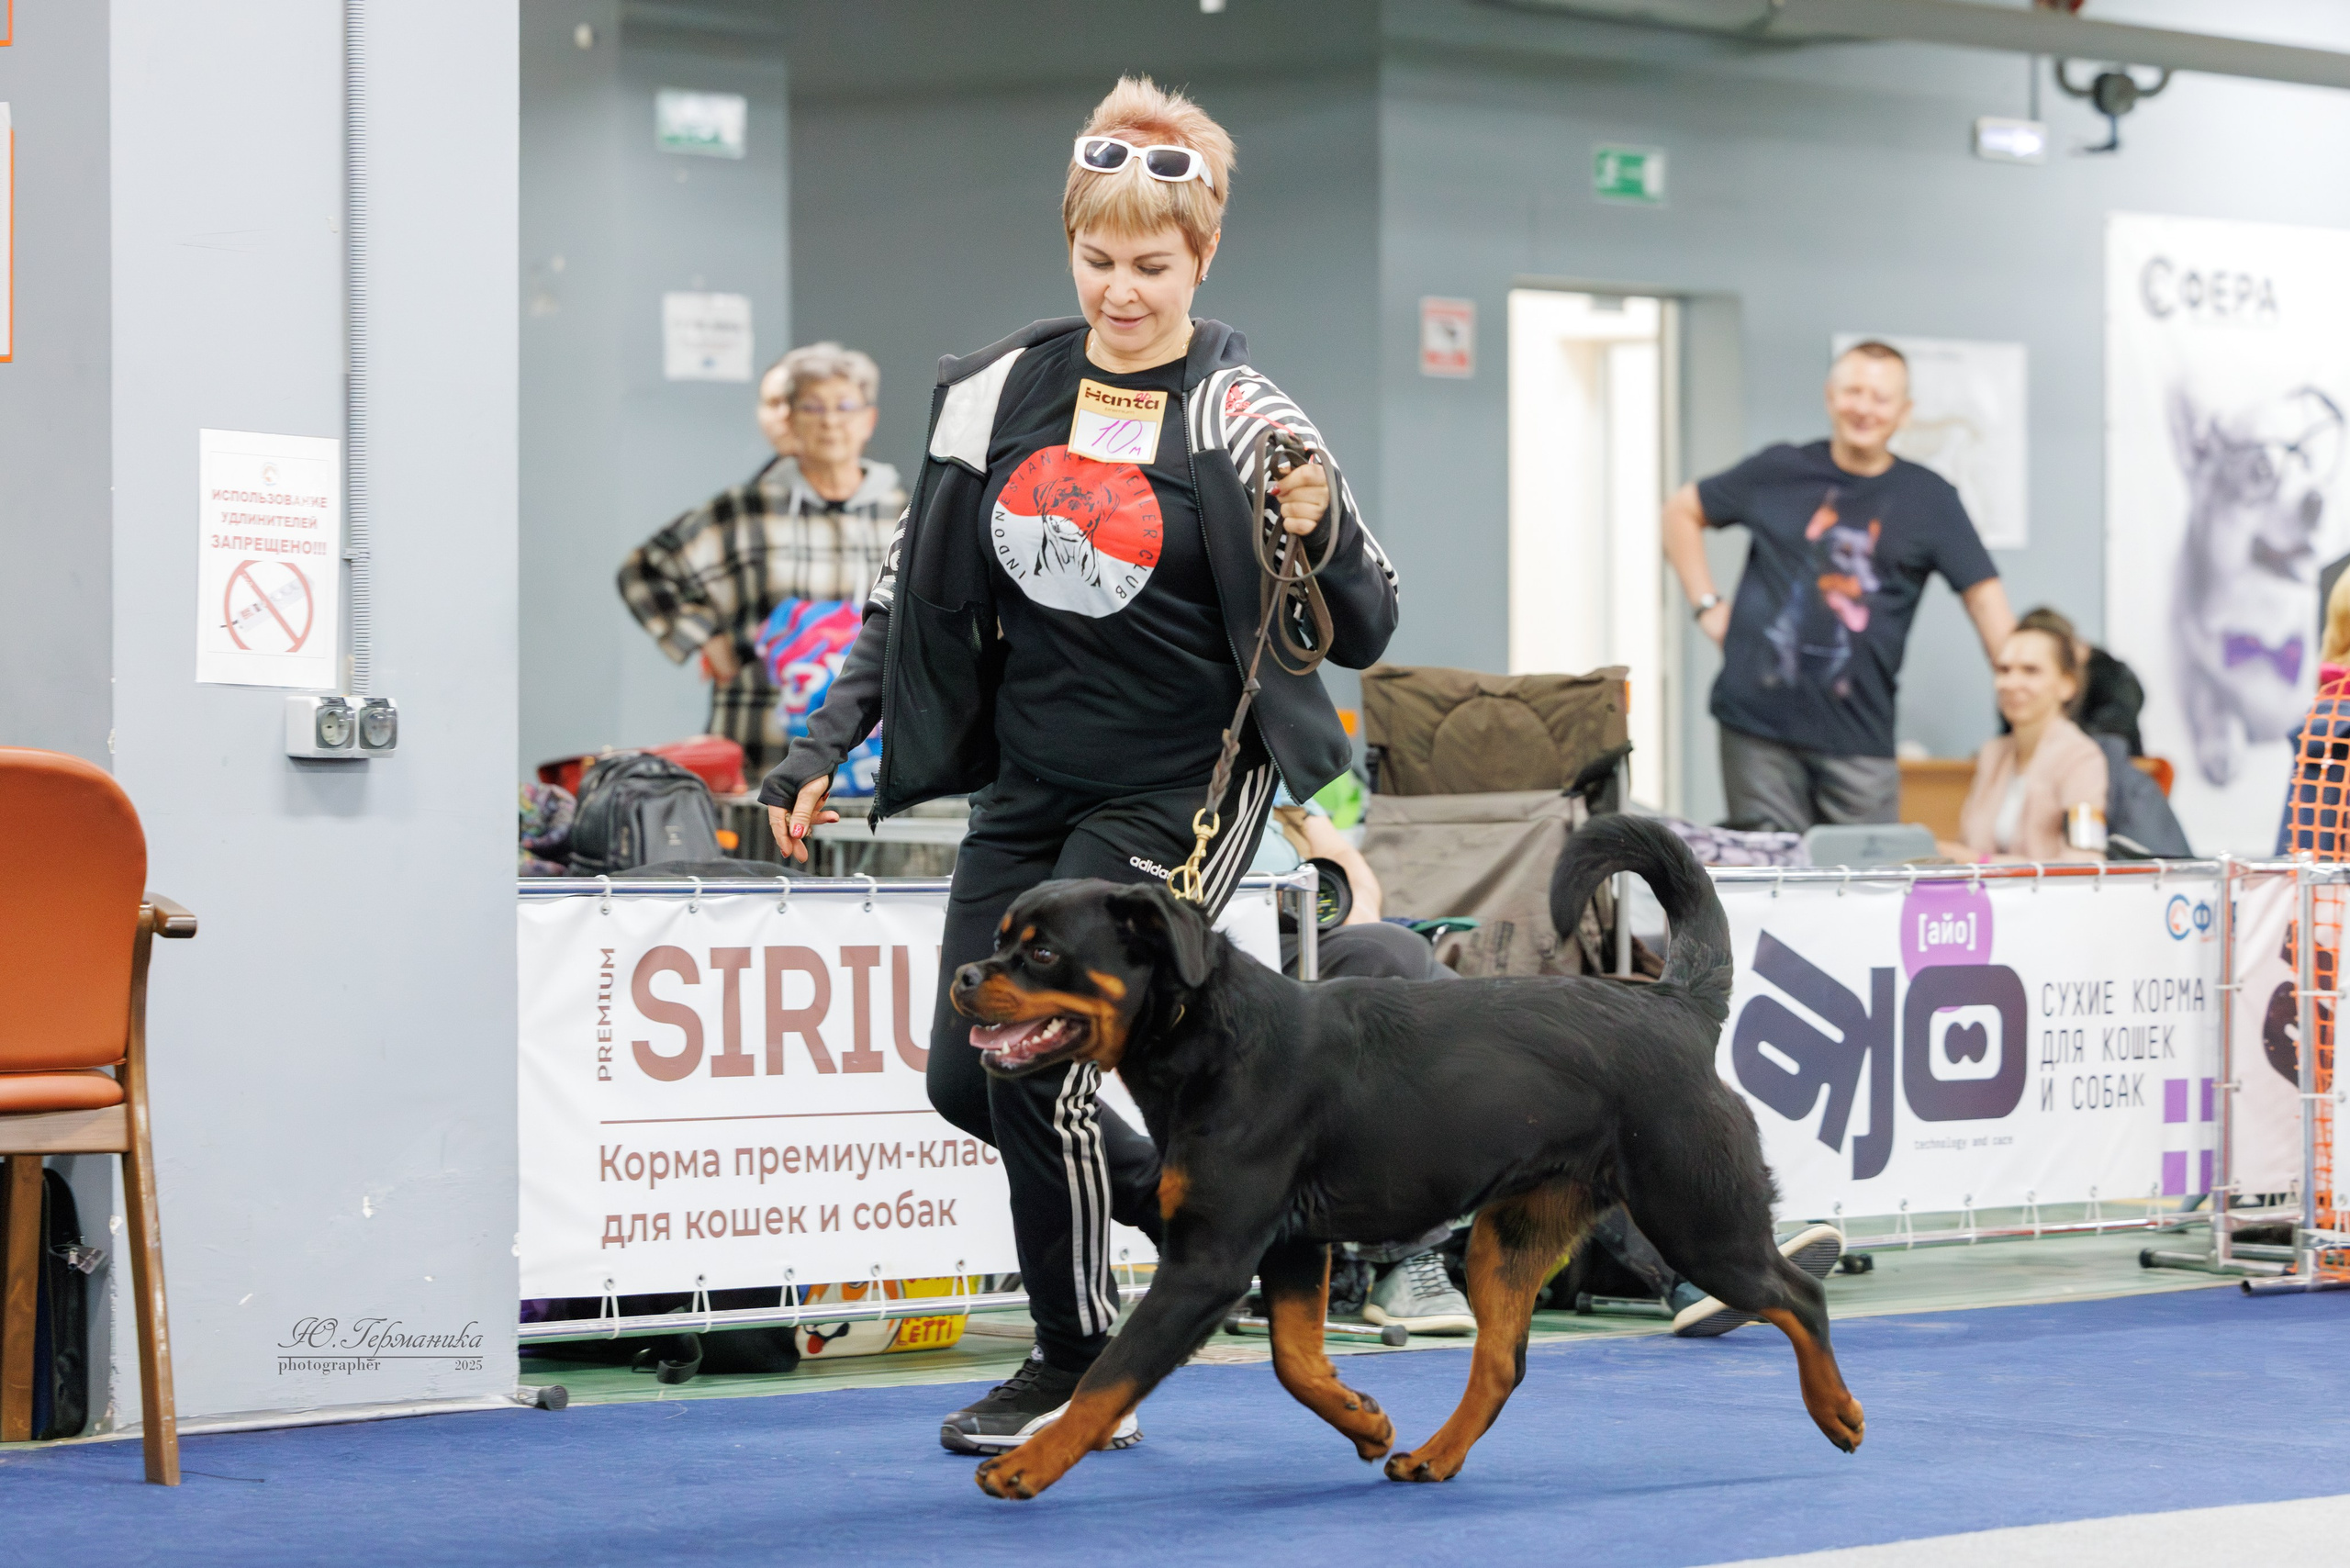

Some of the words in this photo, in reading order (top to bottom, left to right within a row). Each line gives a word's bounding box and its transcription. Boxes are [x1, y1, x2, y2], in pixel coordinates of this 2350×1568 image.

[2137, 254, 2280, 319] СФЕРА
[220, 510, 319, 530] УДЛИНИТЕЛЕЙ
[994, 451, 1051, 580] INDONESIAN
[1115, 549, 1154, 599] CLUB
[210, 533, 328, 555] ЗАПРЕЩЕНО!!!
[597, 947, 617, 1082] PREMIUM
[2042, 980, 2115, 1016] СУХИЕ
[2132, 978, 2205, 1014] КОРМА
[2040, 1028, 2084, 1071] ДЛЯ
[2102, 1025, 2176, 1061] КОШЕК
[2041, 1077, 2053, 1112] И
[2071, 1072, 2145, 1110] СОБАК
[599, 1144, 721, 1190] Корма
[600, 1211, 671, 1249] для
[685, 1204, 808, 1240] кошек
[820, 1204, 840, 1233] и
[853, 1189, 958, 1231] собак
